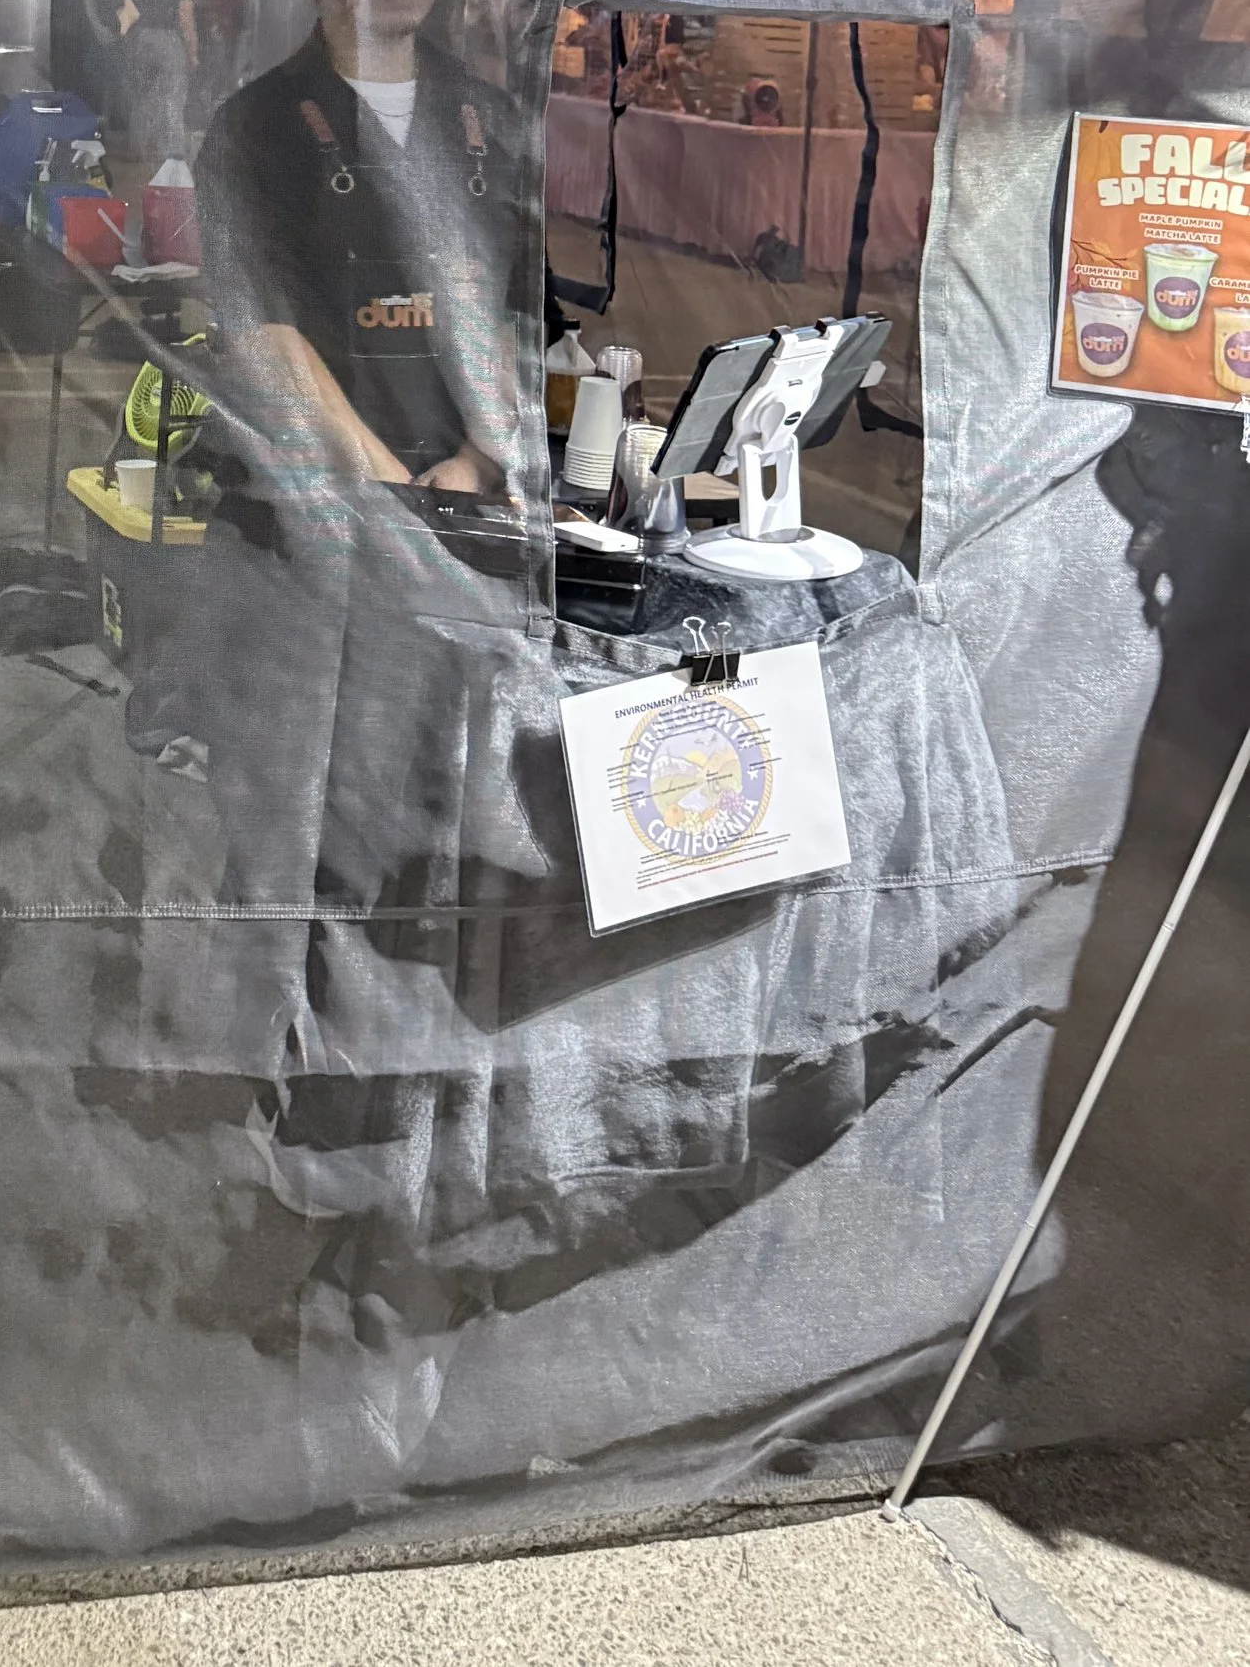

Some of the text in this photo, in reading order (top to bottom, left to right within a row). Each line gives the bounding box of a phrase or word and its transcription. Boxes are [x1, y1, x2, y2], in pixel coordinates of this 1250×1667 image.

[1120, 133, 1250, 184] FALL
[1097, 176, 1250, 217] SPECIAL
[1140, 214, 1222, 229] MAPLE PUMPKIN
[1145, 228, 1220, 244] MATCHA LATTE
[1075, 265, 1138, 279] PUMPKIN PIE
[1090, 278, 1121, 289] LATTE
[614, 676, 759, 719] ENVIRONMENTAL HEALTH PERMIT
